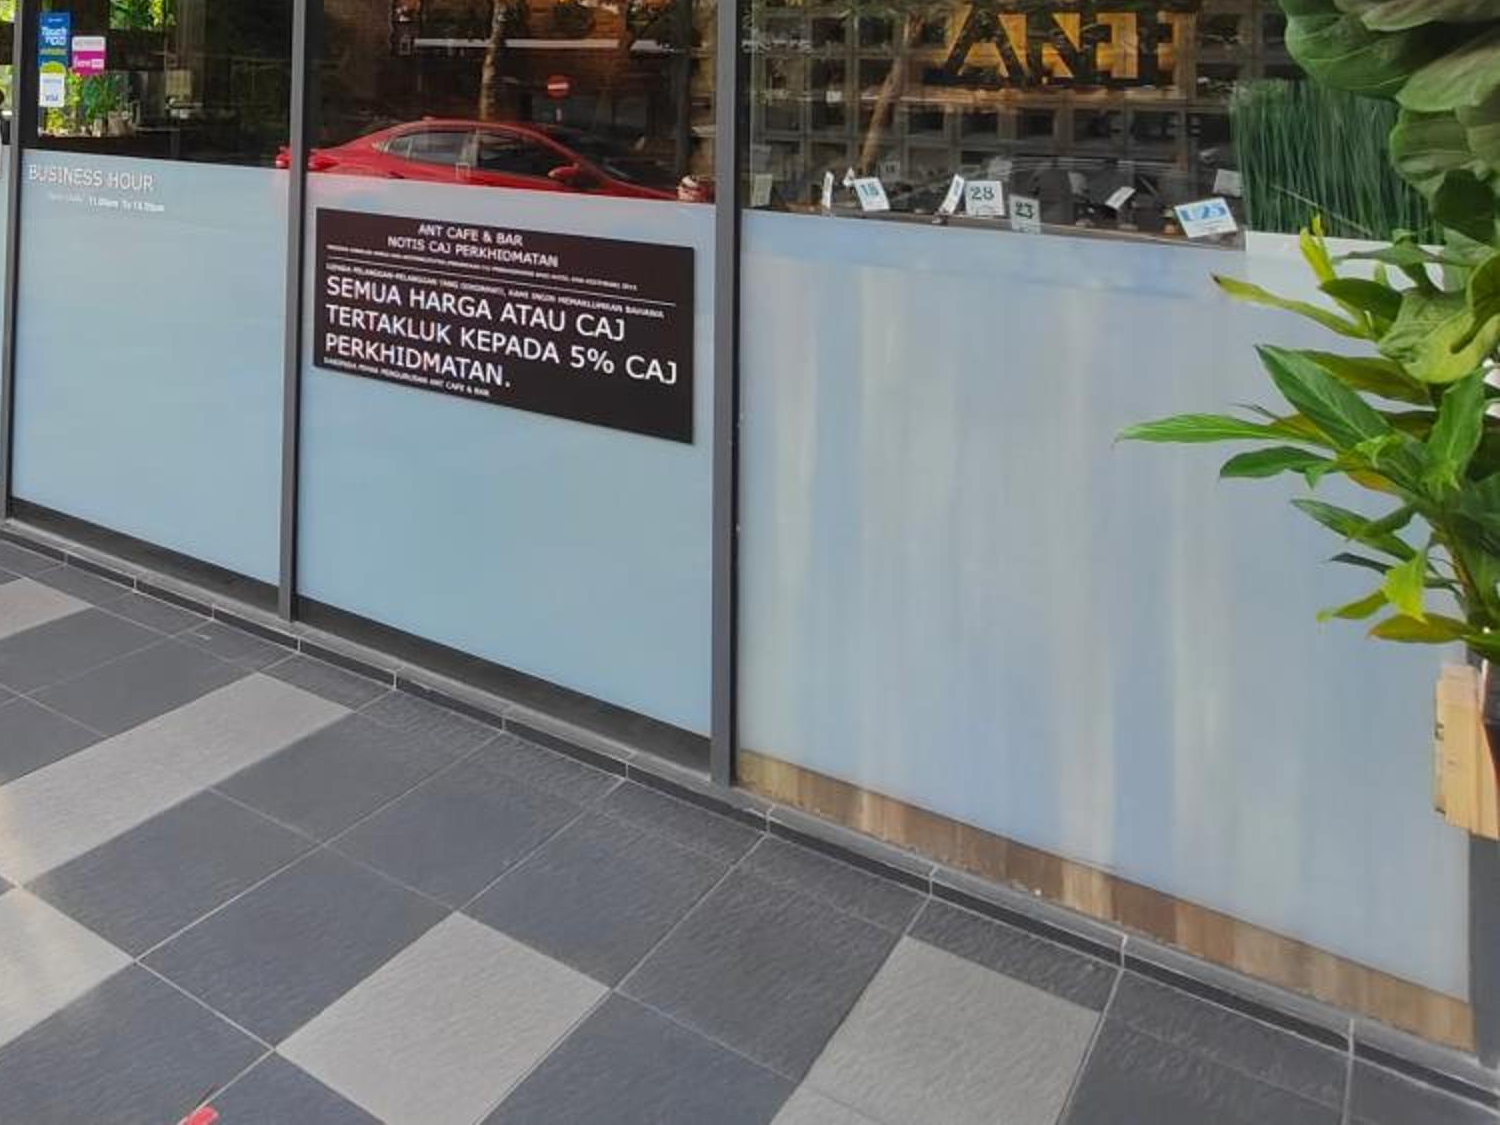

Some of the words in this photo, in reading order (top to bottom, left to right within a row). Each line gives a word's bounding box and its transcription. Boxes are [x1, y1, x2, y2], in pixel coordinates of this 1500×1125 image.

[29, 163, 103, 188] BUSINESS
[106, 171, 155, 194] HOUR
[970, 186, 995, 200] 28
[418, 223, 443, 236] ANT
[446, 226, 479, 242] CAFE
[482, 230, 492, 243] &
[496, 232, 523, 246] BAR
[388, 236, 425, 251] NOTIS
[428, 240, 451, 254] CAJ
[455, 243, 559, 267] PERKHIDMATAN
[326, 275, 402, 306] SEMUA
[409, 290, 492, 321] HARGA
[500, 302, 566, 332] ATAU
[575, 313, 626, 342] CAJ
[325, 304, 451, 344] TERTAKLUK
[460, 327, 560, 364] KEPADA
[570, 345, 615, 374] 5%
[625, 354, 678, 385] CAJ
[325, 332, 511, 388] PERKHIDMATAN.
